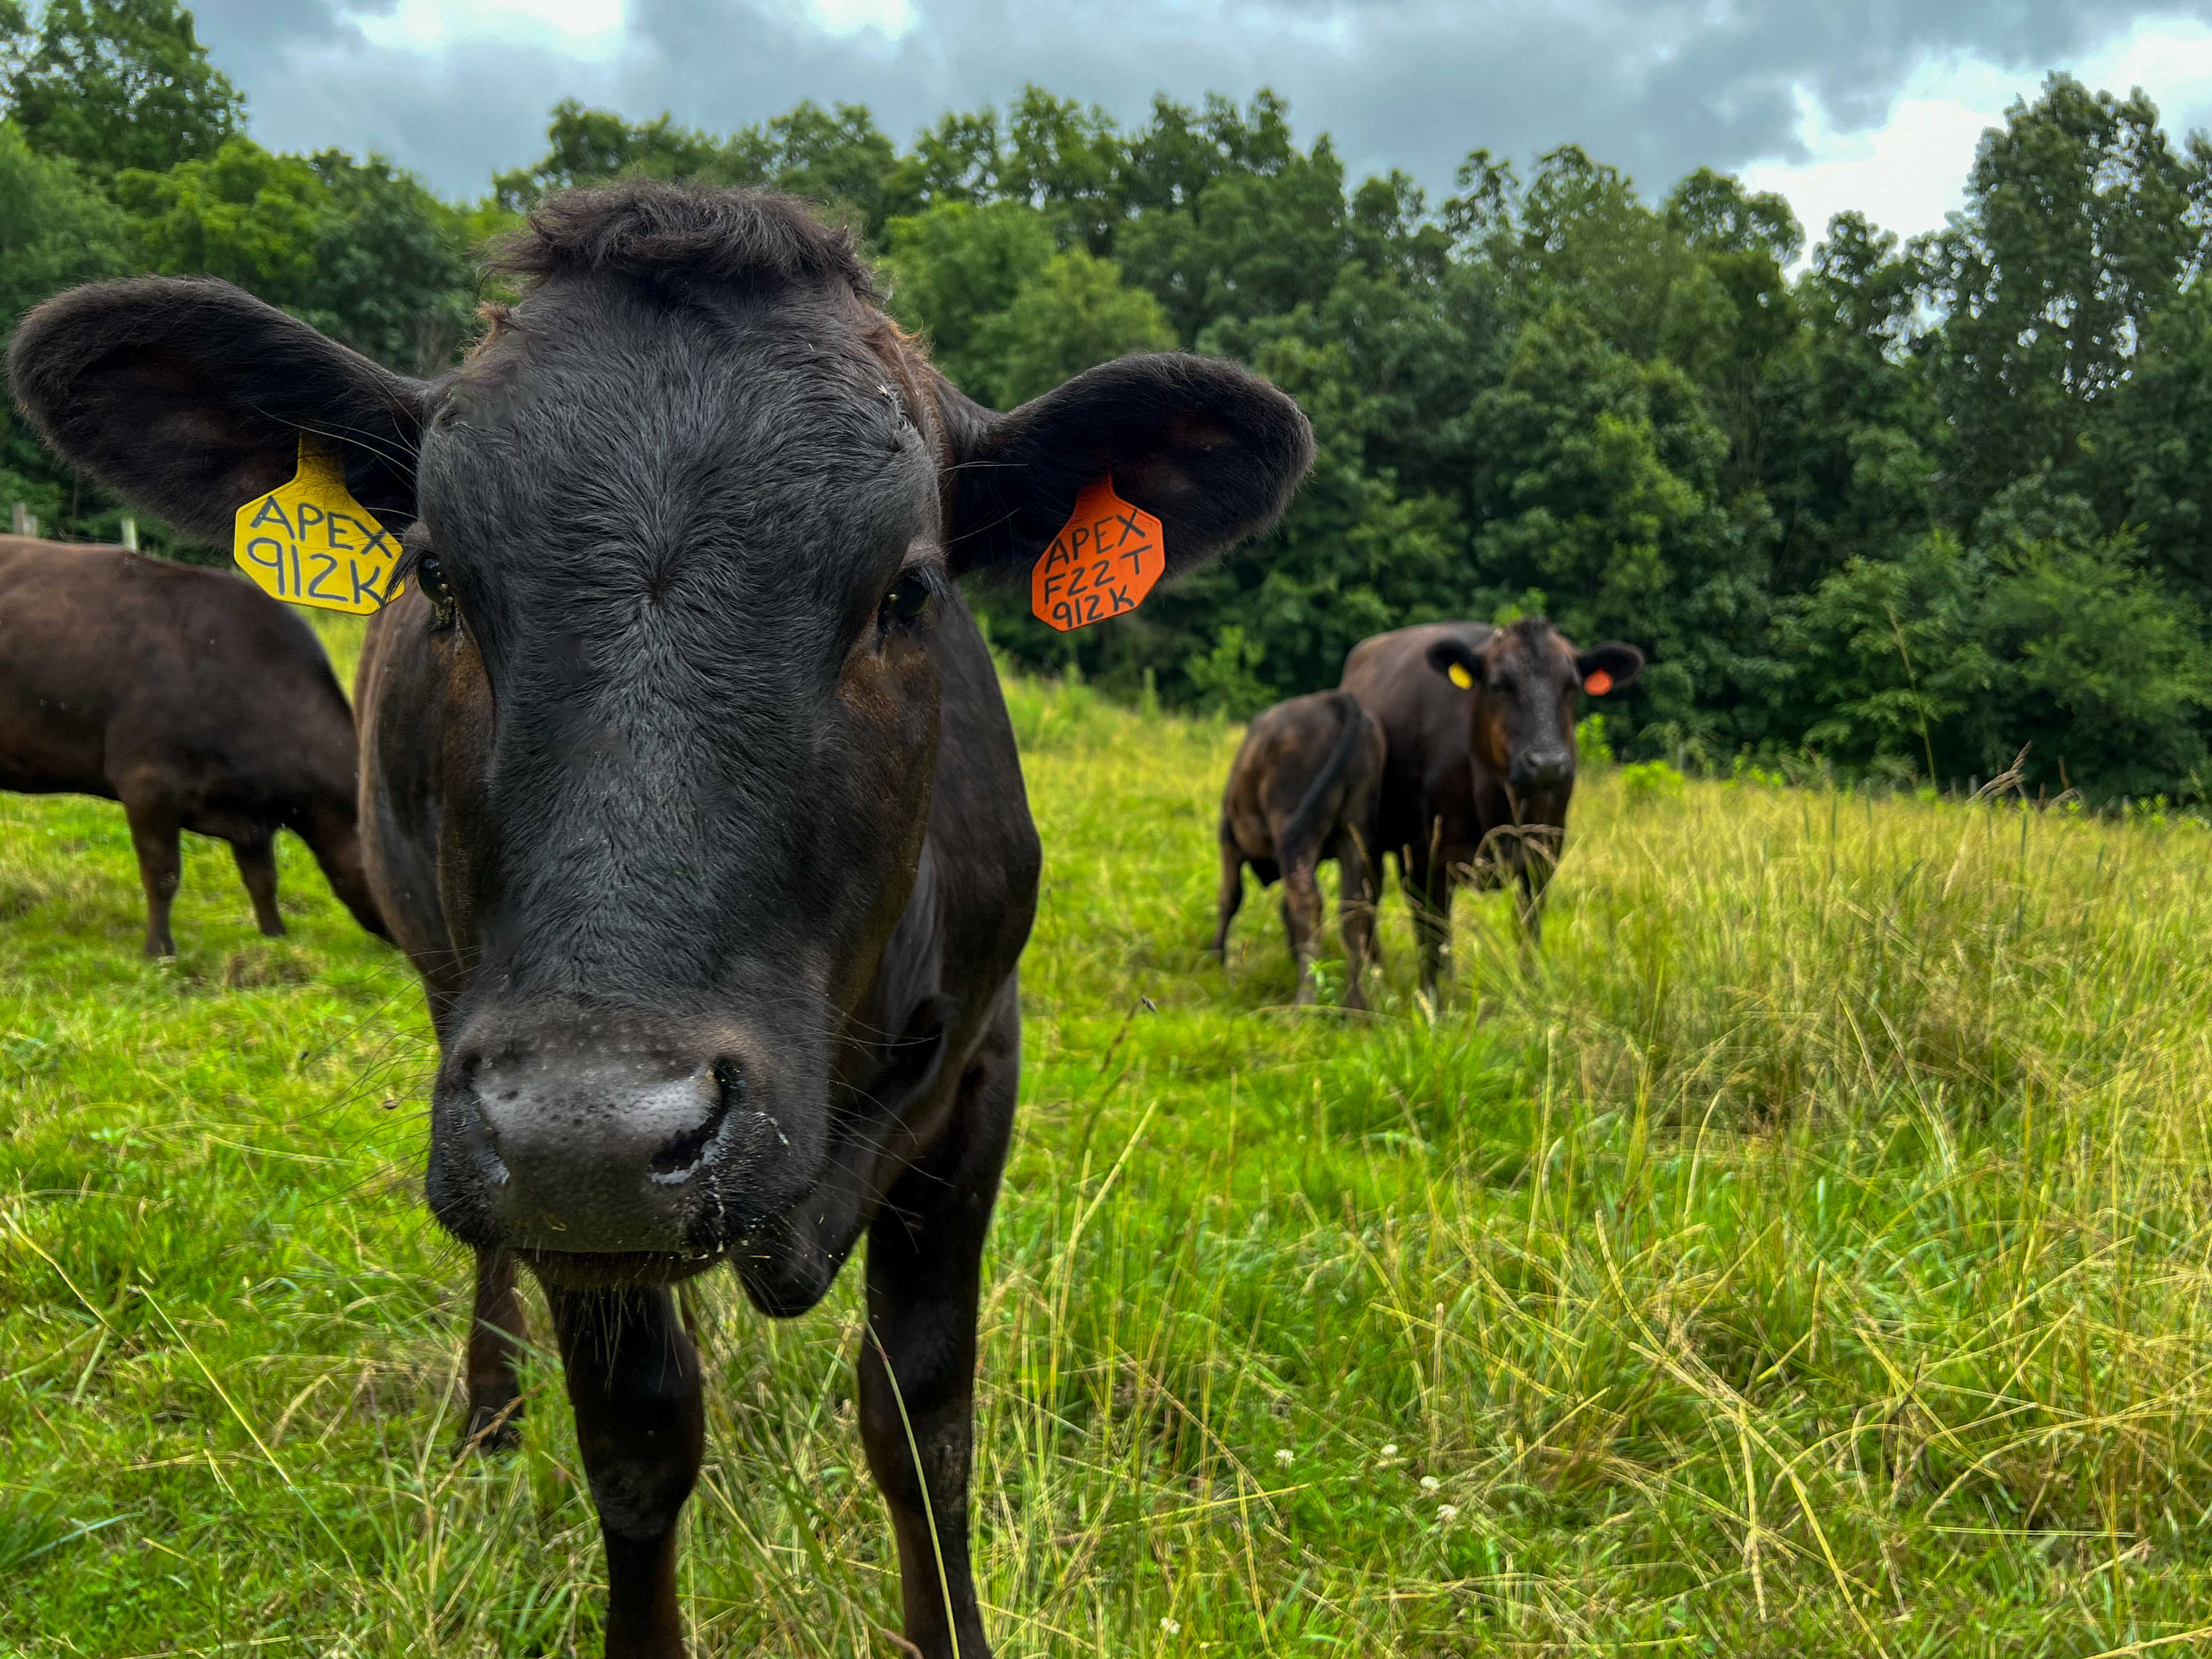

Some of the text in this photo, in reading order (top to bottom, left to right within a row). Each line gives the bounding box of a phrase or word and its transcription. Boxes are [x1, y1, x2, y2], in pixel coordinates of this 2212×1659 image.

[250, 495, 392, 558] APEX
[1045, 508, 1146, 574] APEX
[247, 537, 385, 607] 912K
[1052, 585, 1134, 628] 912K
